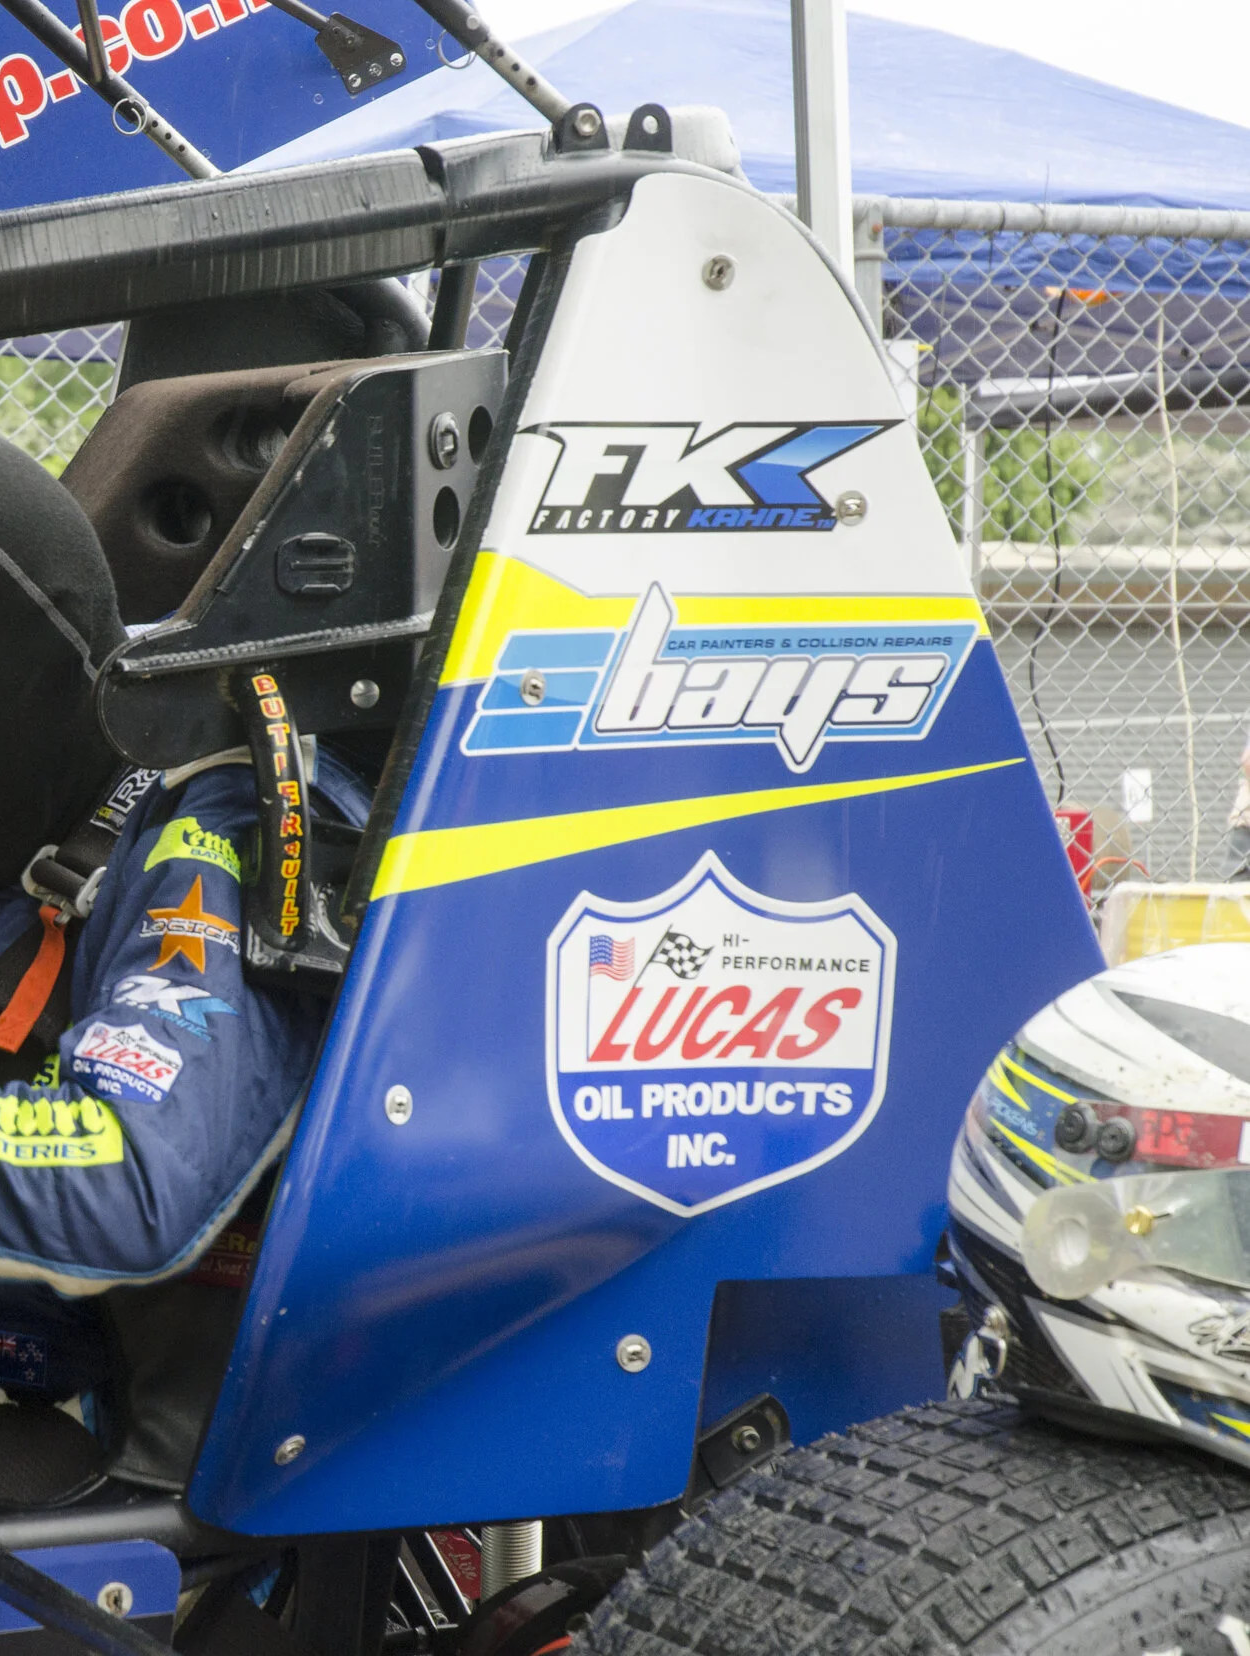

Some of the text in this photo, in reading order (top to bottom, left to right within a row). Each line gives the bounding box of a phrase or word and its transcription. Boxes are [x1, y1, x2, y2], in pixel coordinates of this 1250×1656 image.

[532, 508, 683, 530] FACTORY
[686, 508, 822, 529] KAHNE
[668, 636, 954, 651] CAR PAINTERS & COLLISON REPAIRS
[596, 582, 949, 765] bays
[722, 933, 750, 948] HI-
[722, 955, 871, 973] PERFORMANCE
[588, 985, 863, 1063] LUCAS
[84, 1037, 173, 1080] LUCAS
[93, 1063, 163, 1102] PRODUCTS
[574, 1082, 853, 1121] OIL PRODUCTS
[667, 1133, 736, 1168] INC.
